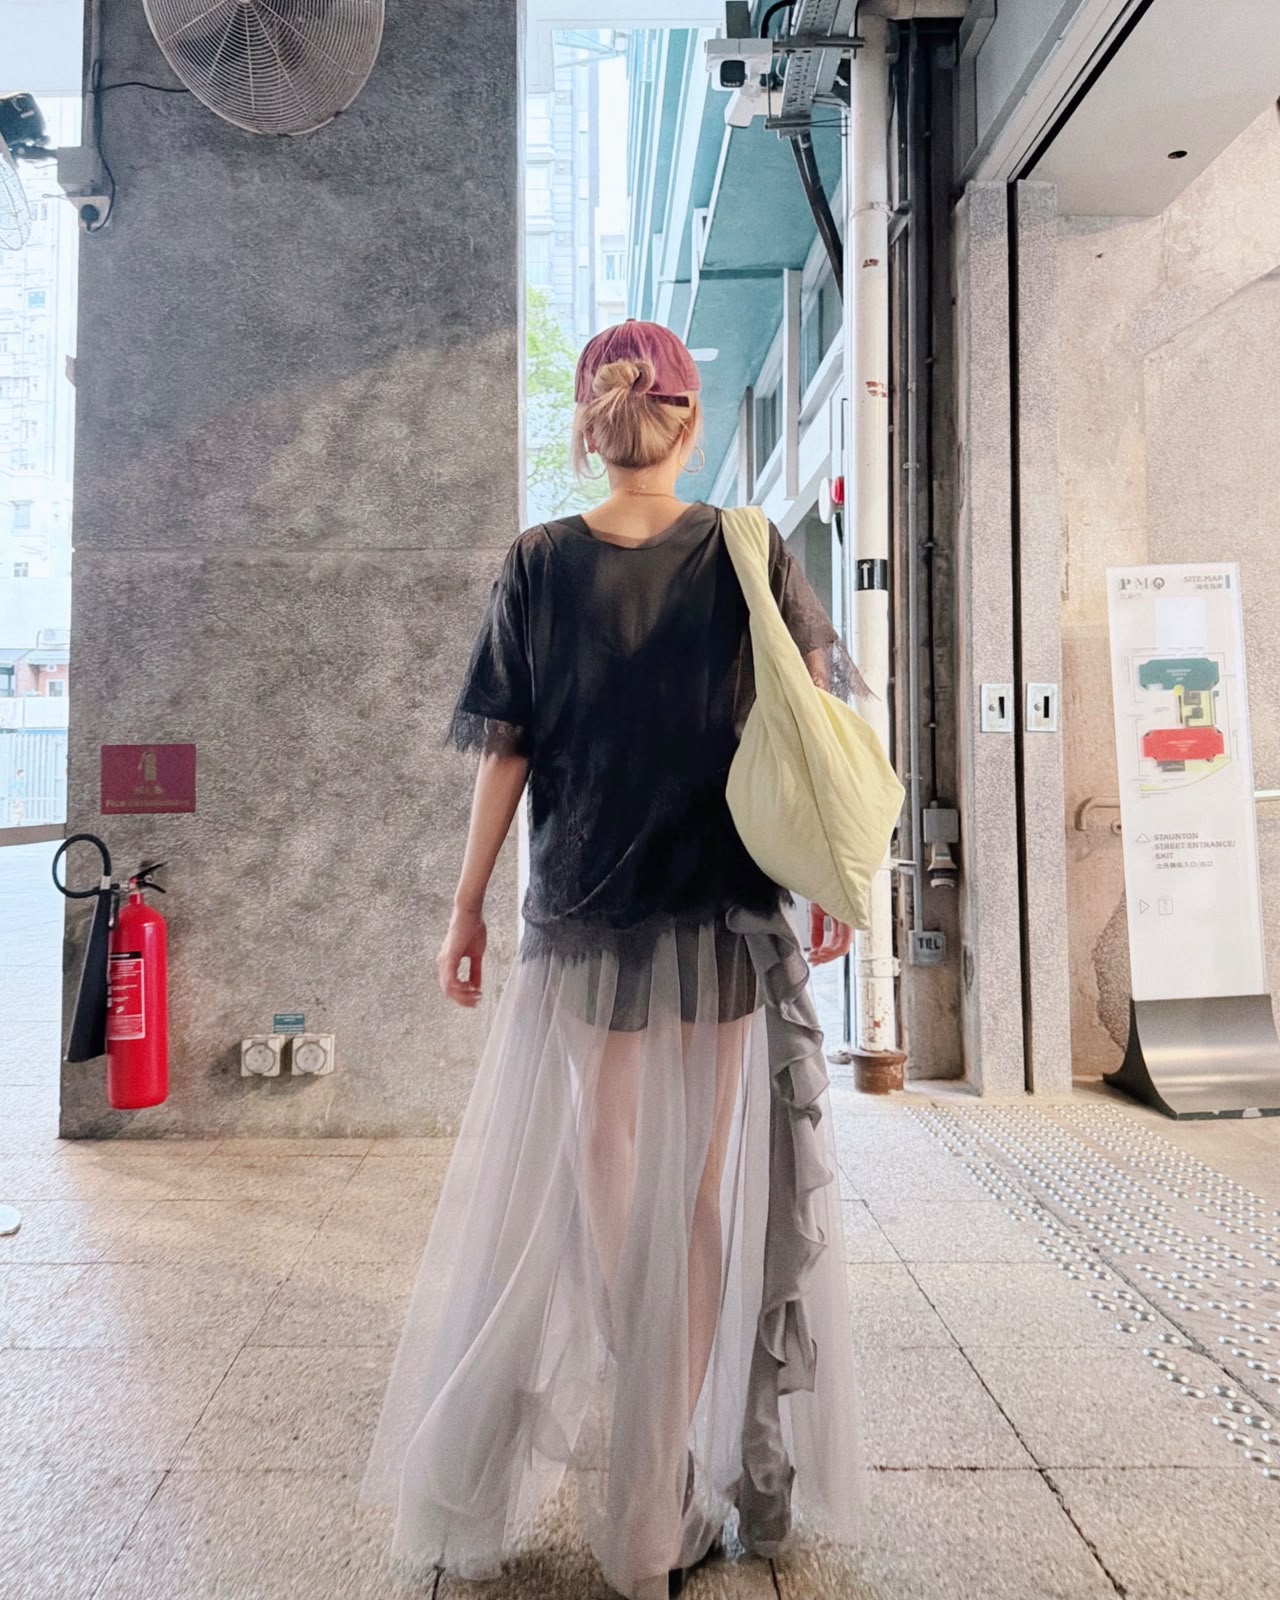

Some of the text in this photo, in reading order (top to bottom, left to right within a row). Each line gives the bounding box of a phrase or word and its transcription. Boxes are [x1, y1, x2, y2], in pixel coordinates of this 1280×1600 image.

[1120, 577, 1165, 590] PMQ
[1154, 832, 1199, 841] STAUNTON
[1154, 842, 1185, 850] STREET
[1155, 852, 1174, 860] EXIT
[917, 937, 941, 950] TEL
